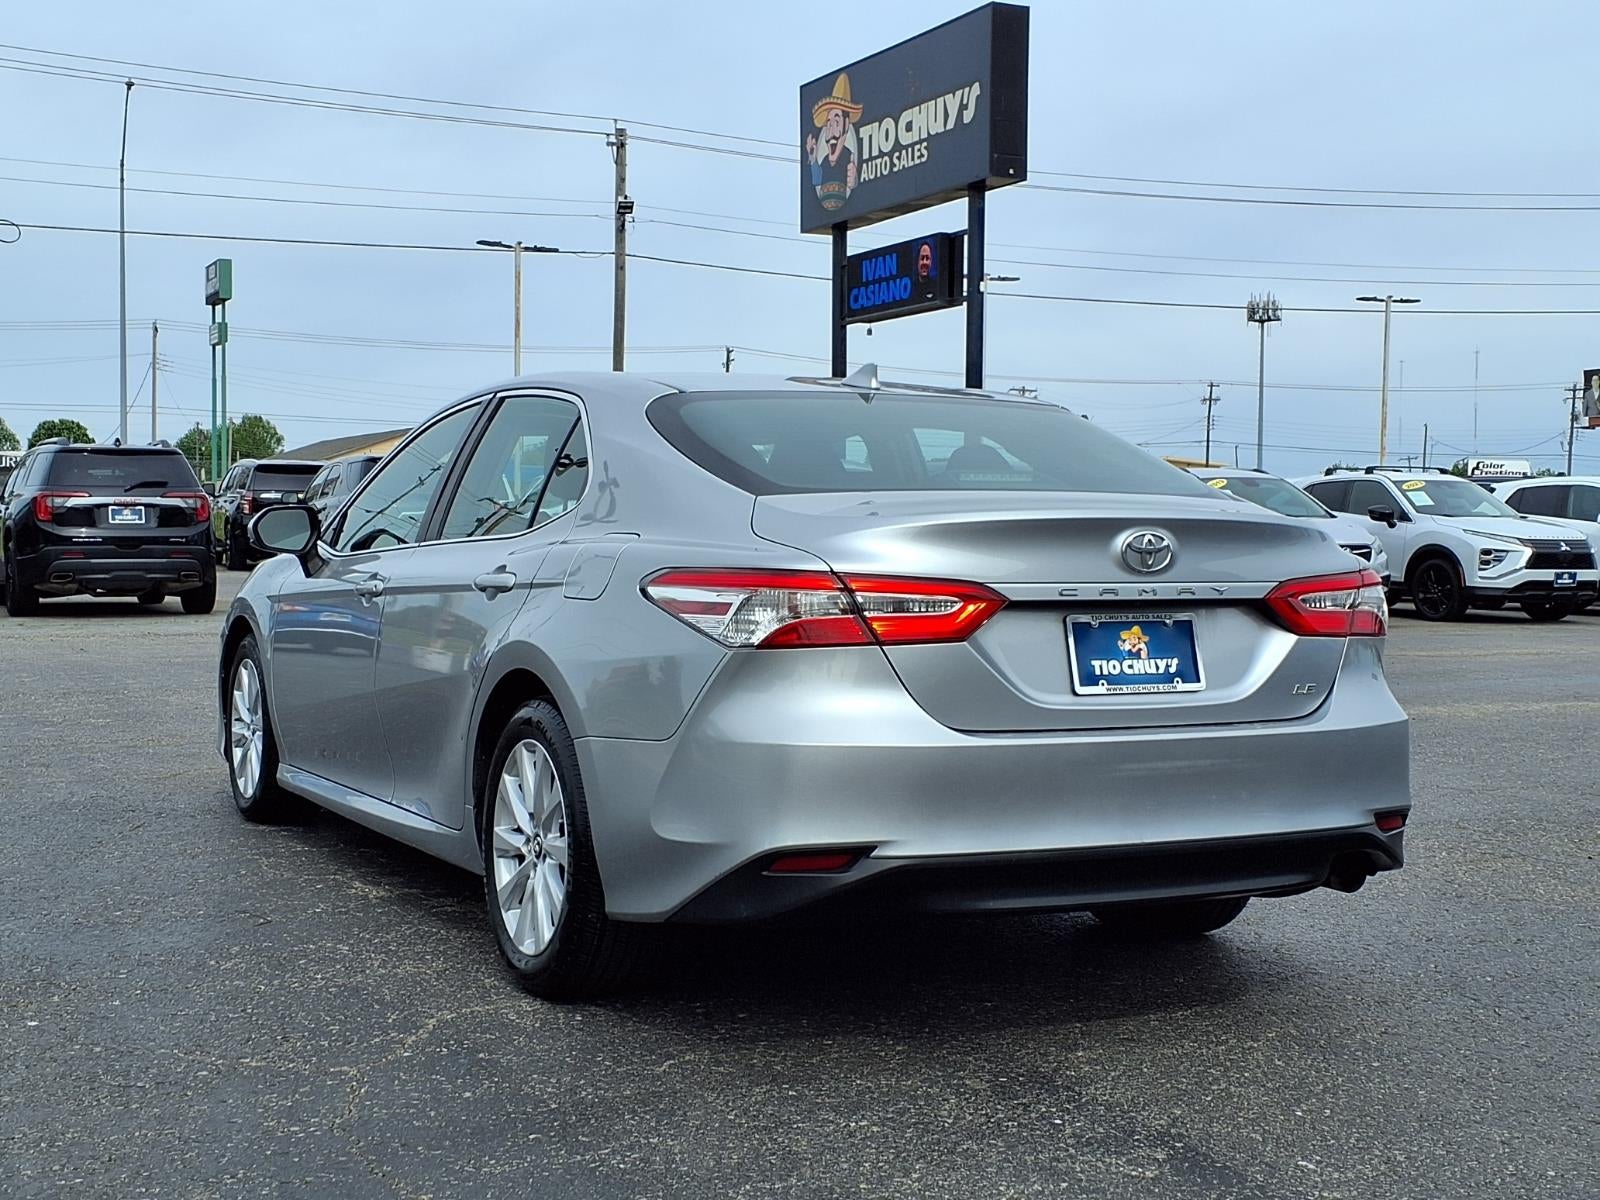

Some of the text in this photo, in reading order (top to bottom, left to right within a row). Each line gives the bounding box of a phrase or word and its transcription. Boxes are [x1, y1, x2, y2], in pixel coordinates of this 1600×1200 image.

[859, 81, 980, 160] TIO CHUY'S
[860, 142, 928, 182] AUTO SALES
[862, 253, 897, 282] IVAN
[850, 277, 911, 310] CASIANO
[1475, 461, 1505, 469] Color
[1058, 586, 1230, 597] CAMRY
[1091, 657, 1179, 675] TIO CHUY'S
[1105, 684, 1178, 693] WWW.TIOCHUYS.COM
[1292, 683, 1317, 695] LE
